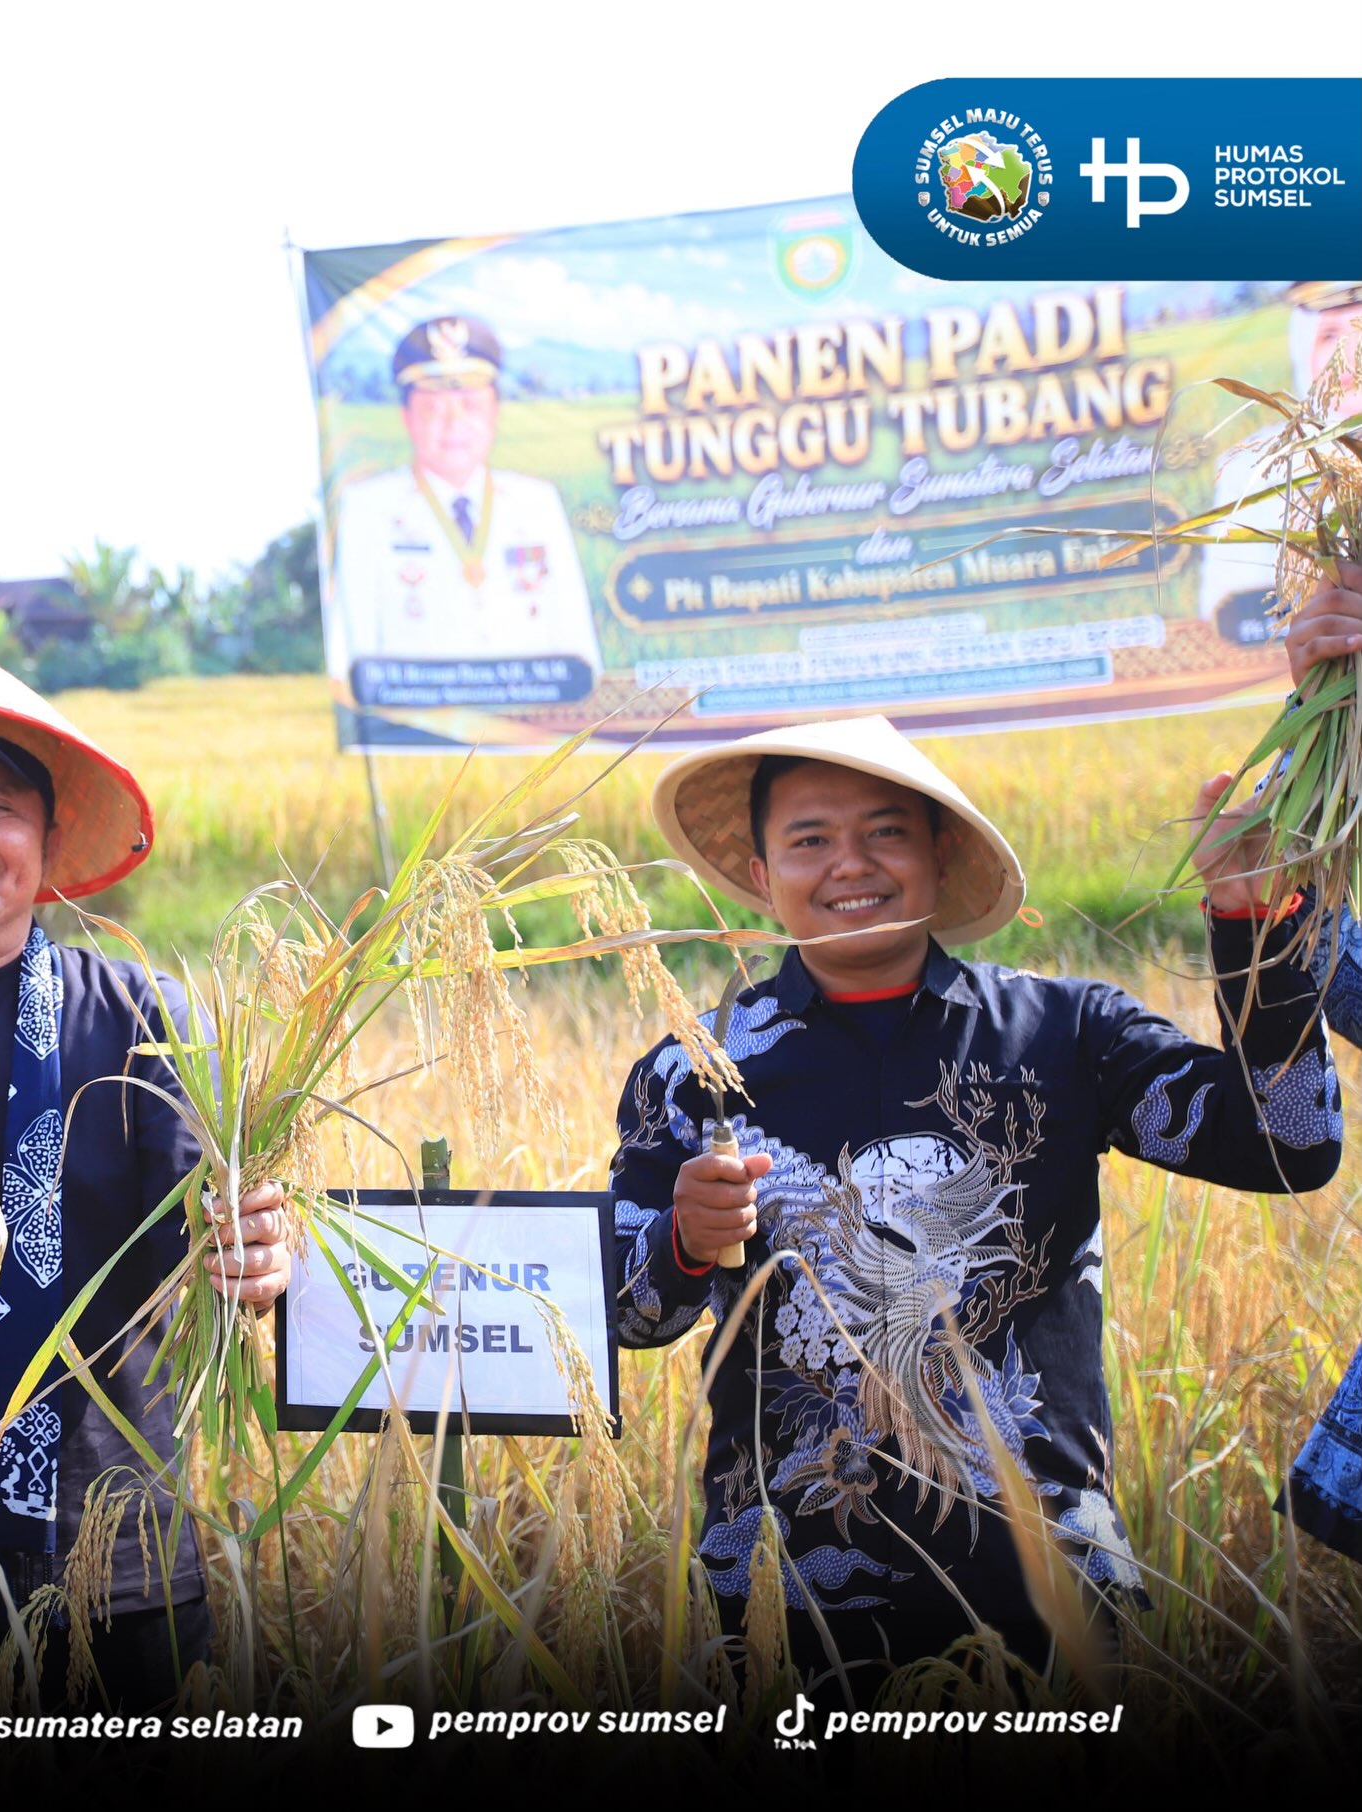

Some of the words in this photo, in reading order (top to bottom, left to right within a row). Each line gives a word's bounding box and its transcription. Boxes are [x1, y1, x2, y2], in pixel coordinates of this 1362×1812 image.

[639, 318, 905, 415] PANEN
[927, 286, 1127, 382] PADI
[600, 399, 871, 484] TUNGGU
[890, 359, 1174, 455] TUBANG
[889, 457, 1035, 515] Sumatera
[1039, 437, 1155, 496] Selatan
[711, 569, 802, 613] Bupati
[806, 559, 957, 602] Kabupaten
[960, 549, 1057, 586] Muara
[855, 527, 913, 566] dan
[358, 1324, 534, 1353] SUMSEL
